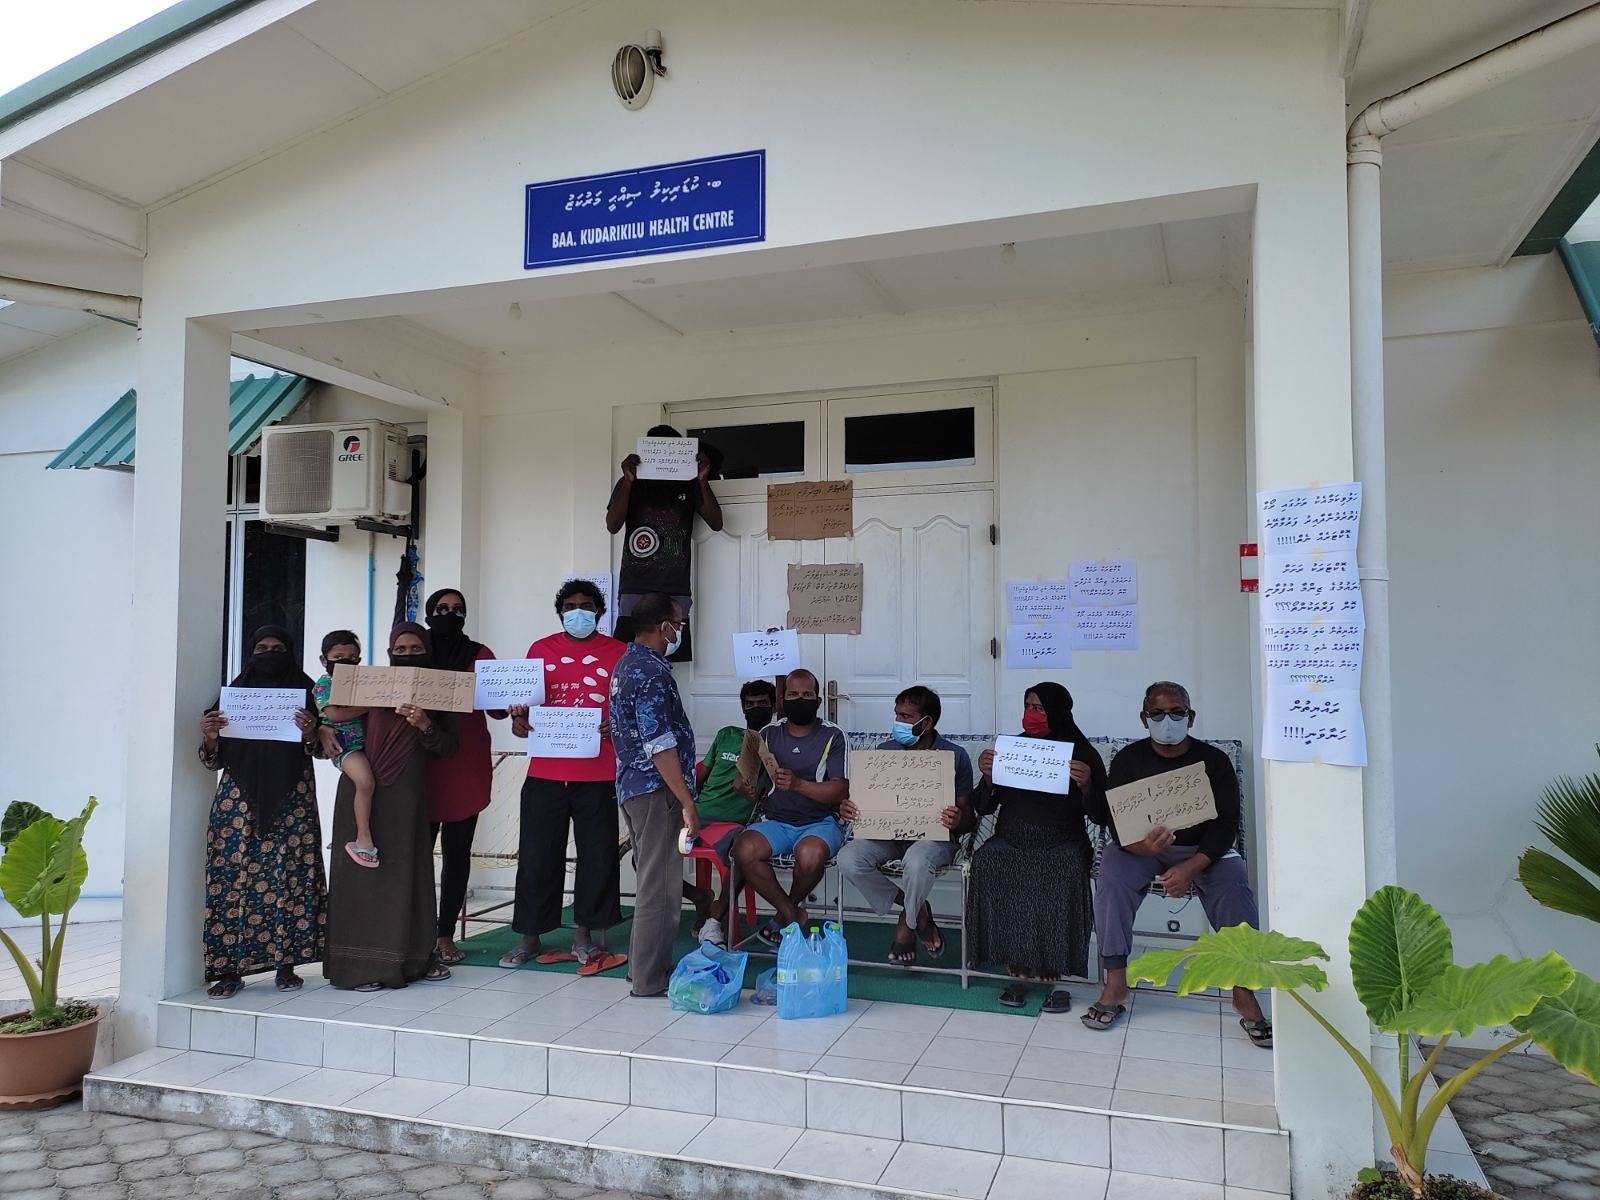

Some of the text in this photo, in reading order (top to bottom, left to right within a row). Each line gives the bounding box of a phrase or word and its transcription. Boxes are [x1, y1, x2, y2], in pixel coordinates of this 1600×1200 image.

[552, 210, 735, 248] BAA. KUDARIKILU HEALTH CENTRE
[338, 453, 365, 462] GREE
